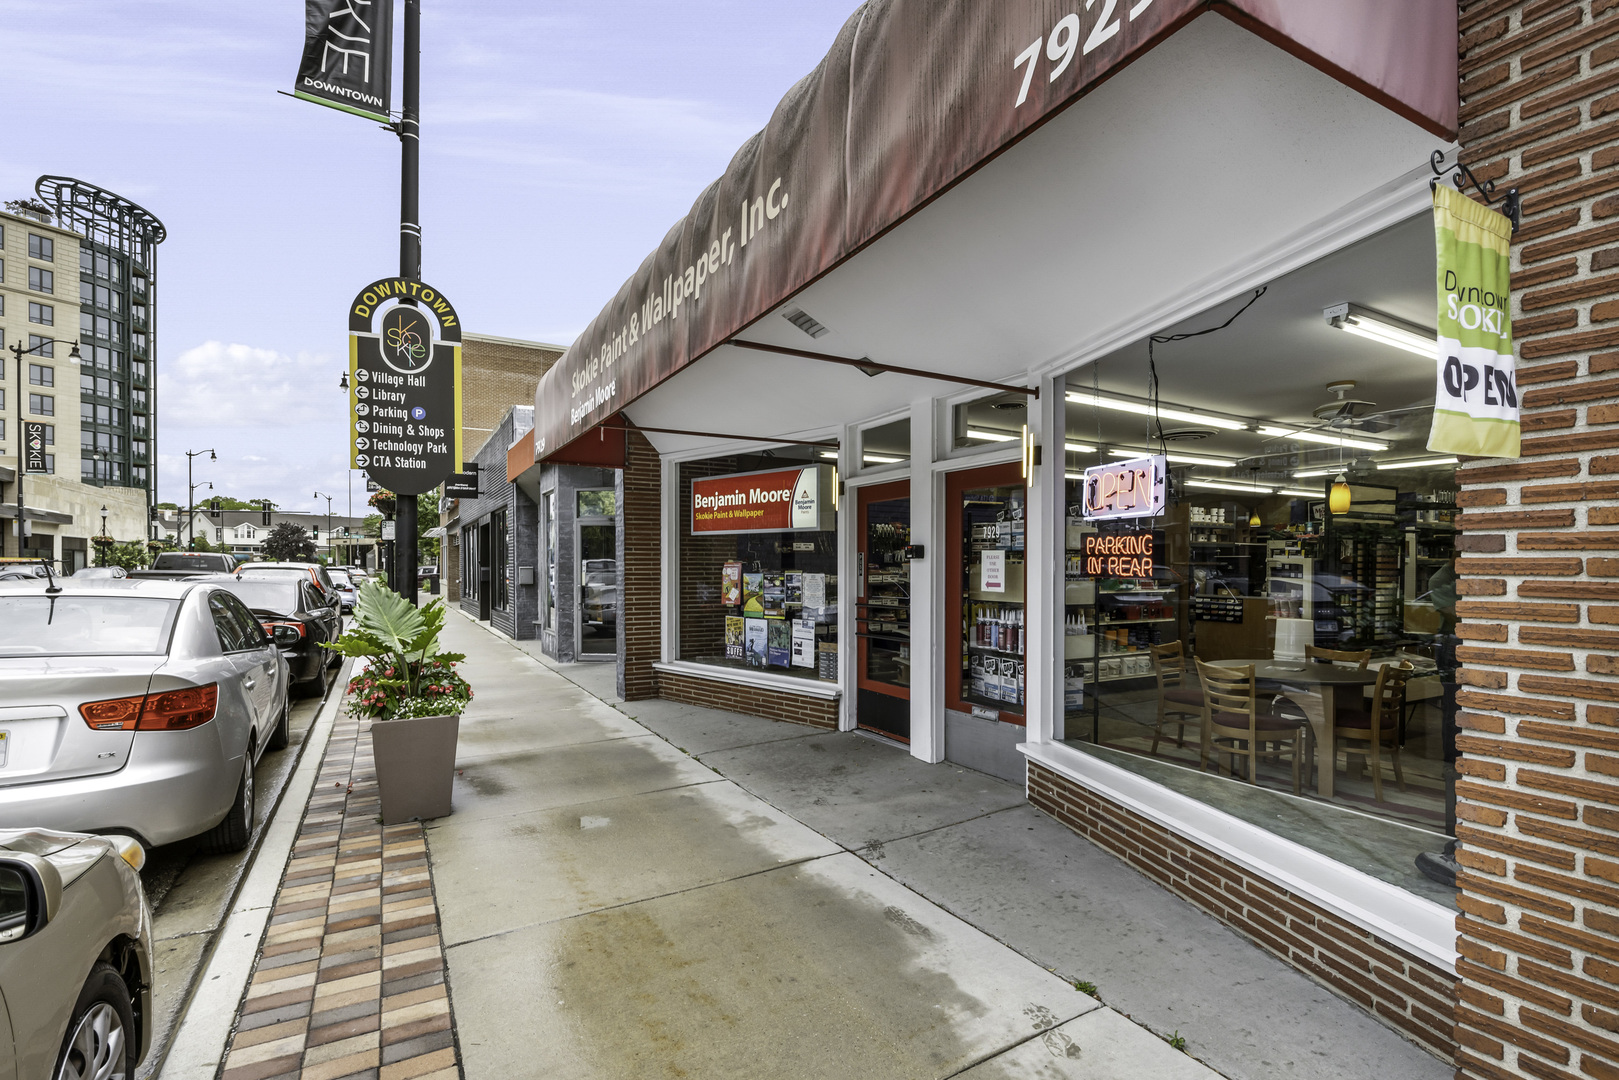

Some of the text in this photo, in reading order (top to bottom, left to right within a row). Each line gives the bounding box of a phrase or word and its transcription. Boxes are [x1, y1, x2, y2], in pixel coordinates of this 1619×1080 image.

[1013, 0, 1154, 109] 792
[304, 76, 383, 108] DOWNTOWN
[572, 177, 788, 398] Skokie Paint & Wallpaper, Inc.
[354, 280, 457, 327] DOWNTOWN
[372, 371, 426, 388] Village Hall
[1443, 355, 1518, 409] OPEN
[372, 388, 406, 405] Library
[570, 380, 616, 426] Benjamin Moore
[372, 405, 408, 422] Parking
[373, 422, 445, 440] Dining & Shops
[372, 438, 448, 455] Technology Park
[373, 456, 427, 469] CTA Station
[1086, 464, 1154, 512] OPEN
[694, 488, 790, 511] Benjamin Moore
[695, 511, 714, 520] Skokie
[714, 510, 728, 520] Paint
[734, 508, 764, 520] Wallpaper
[983, 526, 1000, 538] 7929
[1086, 534, 1152, 555] PARKING
[1087, 556, 1152, 577] IN REAR
[986, 660, 995, 668] DAP
[1003, 662, 1013, 672] DAP
